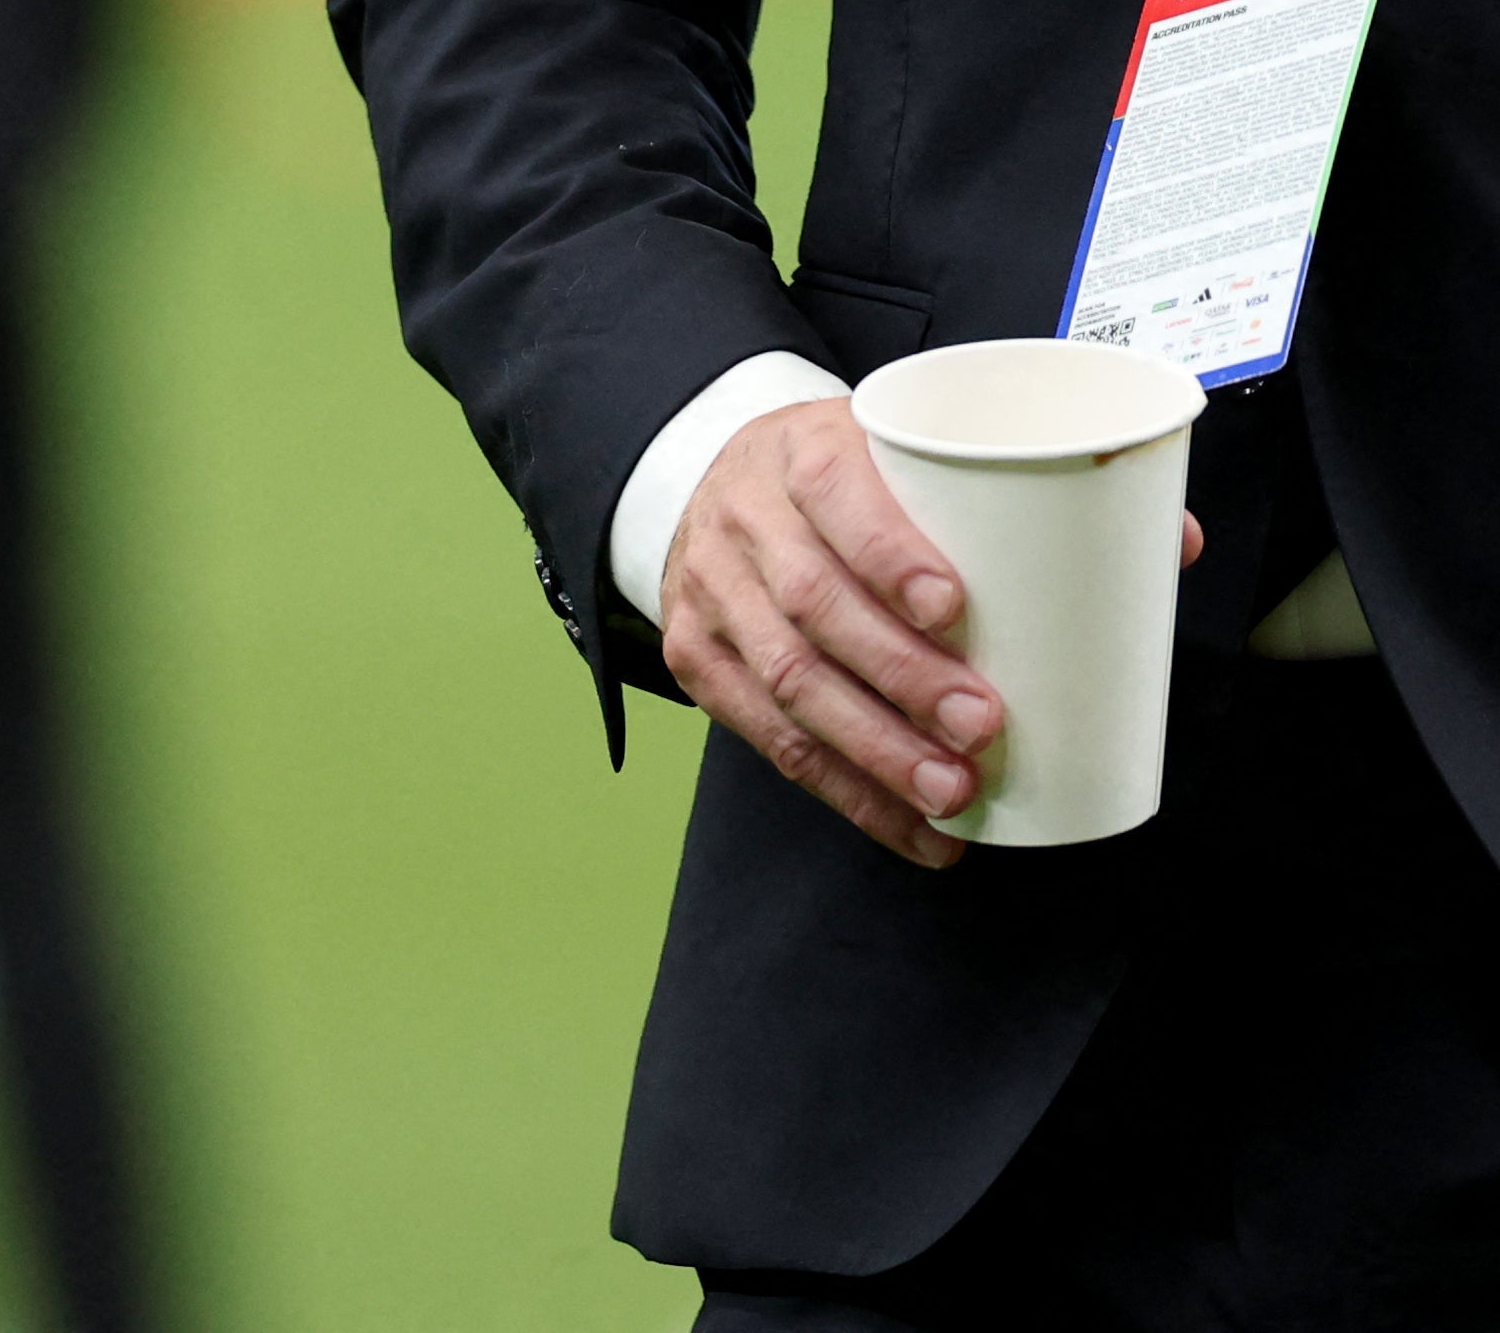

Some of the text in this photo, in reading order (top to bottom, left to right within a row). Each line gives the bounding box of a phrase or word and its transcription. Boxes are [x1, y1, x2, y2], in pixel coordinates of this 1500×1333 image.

[1151, 5, 1248, 41] ACCREDITATION PASS
[1246, 293, 1270, 308] VISA
